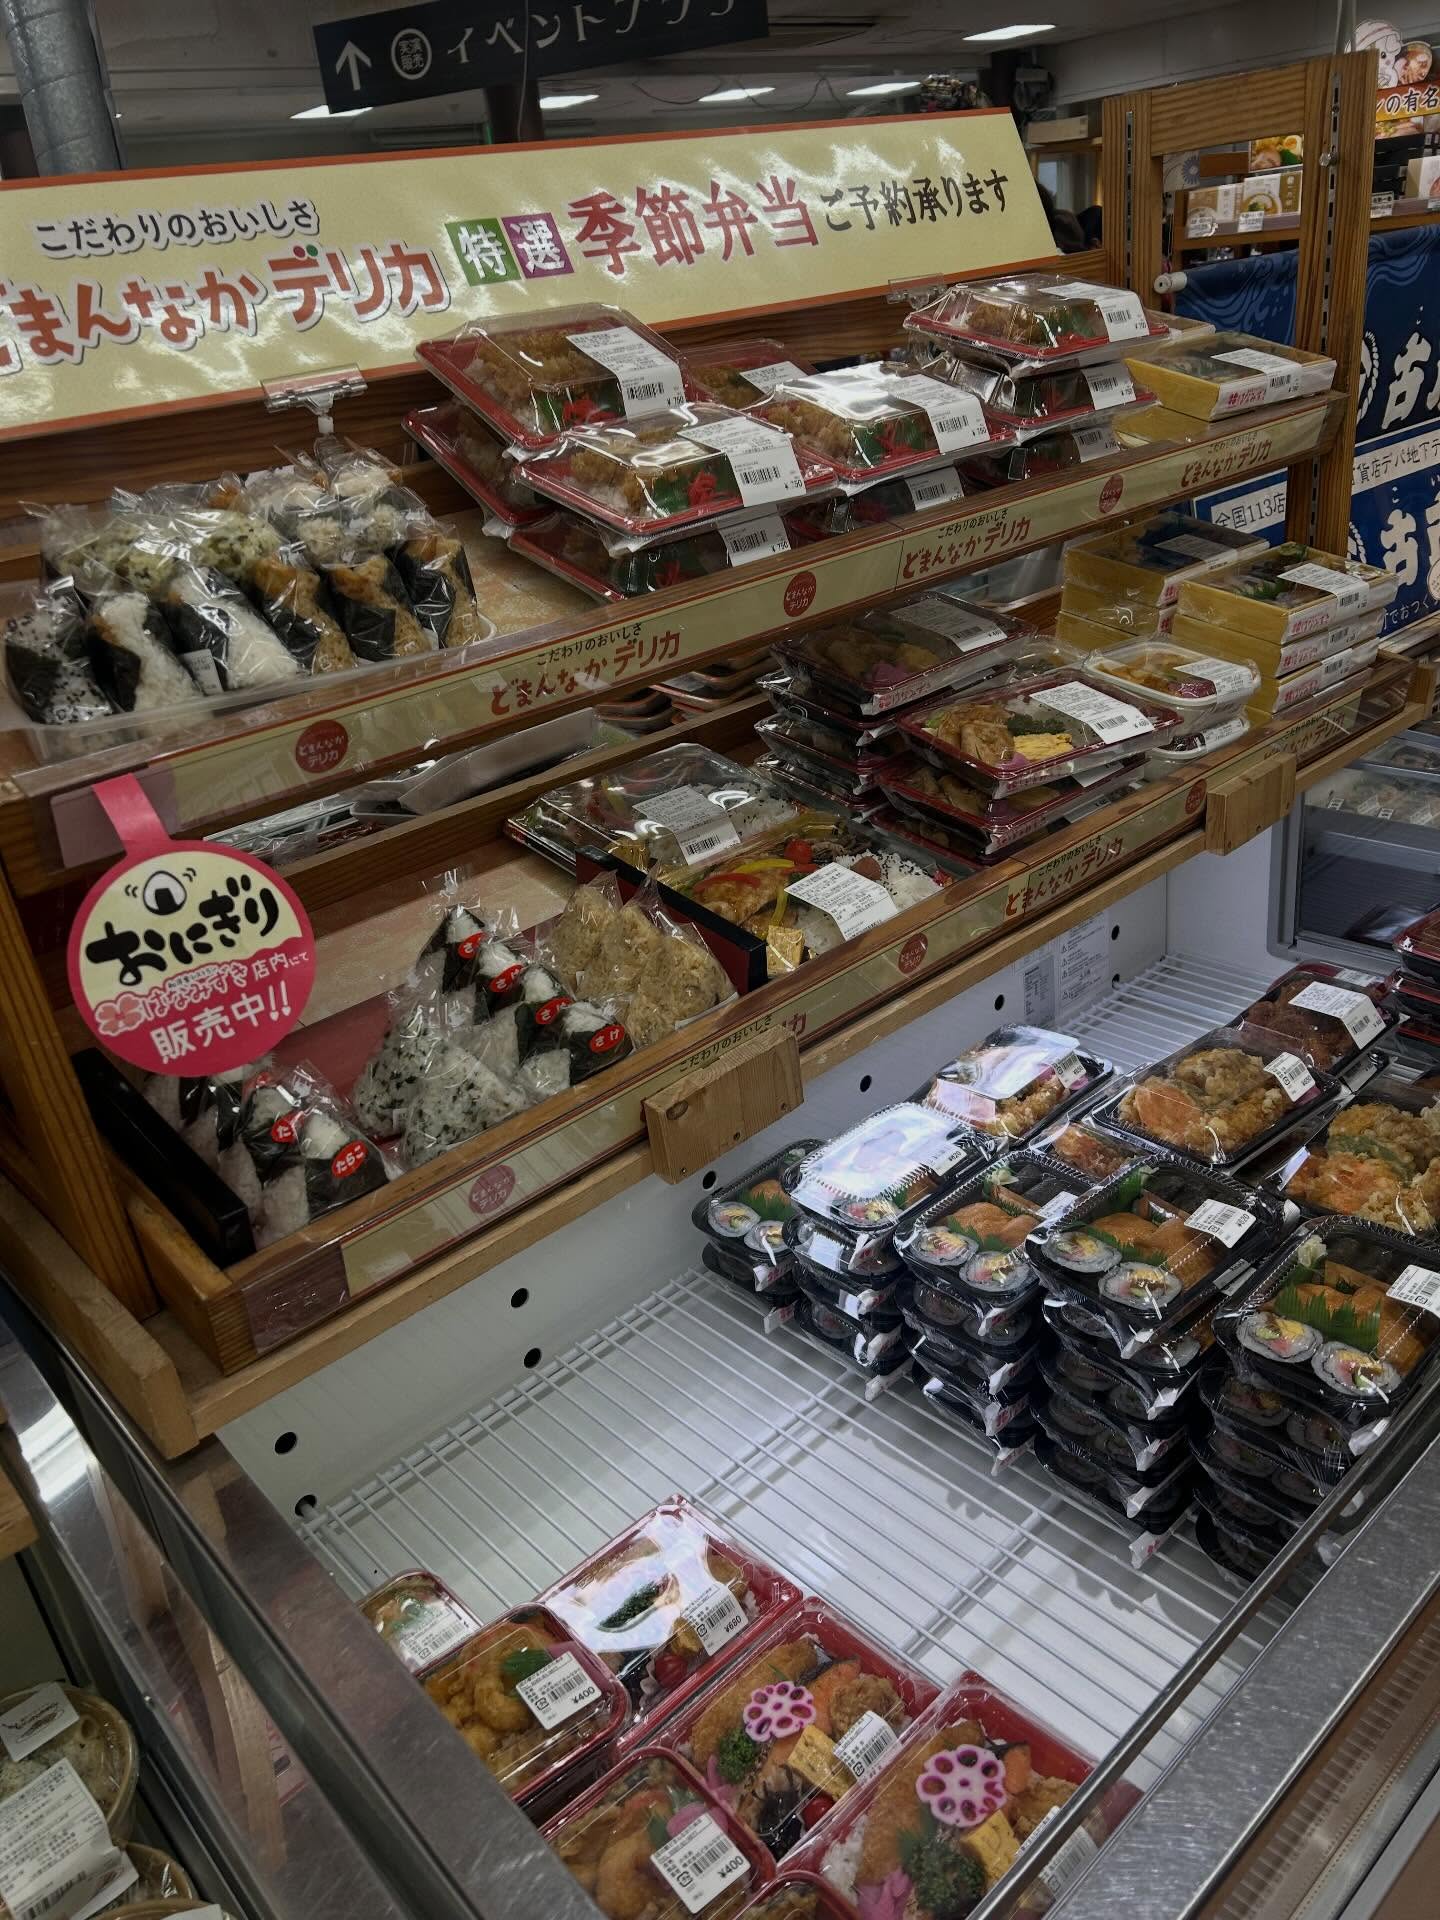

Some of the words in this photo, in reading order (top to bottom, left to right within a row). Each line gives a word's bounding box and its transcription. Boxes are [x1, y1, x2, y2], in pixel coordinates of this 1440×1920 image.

[36, 200, 316, 253] こだわりのおいしさ
[457, 219, 566, 280] 特選
[567, 176, 819, 274] 季節弁当
[820, 168, 1010, 232] ご予約承ります
[0, 244, 447, 367] まんなかデリカ
[1181, 440, 1273, 488] どまんなかデリカ
[1352, 438, 1440, 486] 貨店デパ地下テ
[937, 507, 1009, 539] こだわりのおいしさ
[1215, 492, 1286, 528] 全国113店
[902, 516, 1032, 579] どまんなかデリカ
[1382, 592, 1439, 630] でおつく
[536, 622, 643, 666] こだわりのおいしさ
[491, 630, 681, 716] どまんなかデリカ
[298, 735, 345, 757] どまんなか
[308, 750, 339, 768] デリカ
[86, 874, 280, 986] おにぎり
[252, 951, 309, 981] 店内にて
[150, 980, 292, 1064] 販売中!!
[595, 1028, 620, 1047] さけ
[680, 1013, 773, 1072] こだわりのおいしさ
[335, 1144, 364, 1175] たらこ
[724, 1615, 742, 1633] ¥680
[572, 1686, 596, 1704] ¥400
[718, 1855, 744, 1878] ¥400
